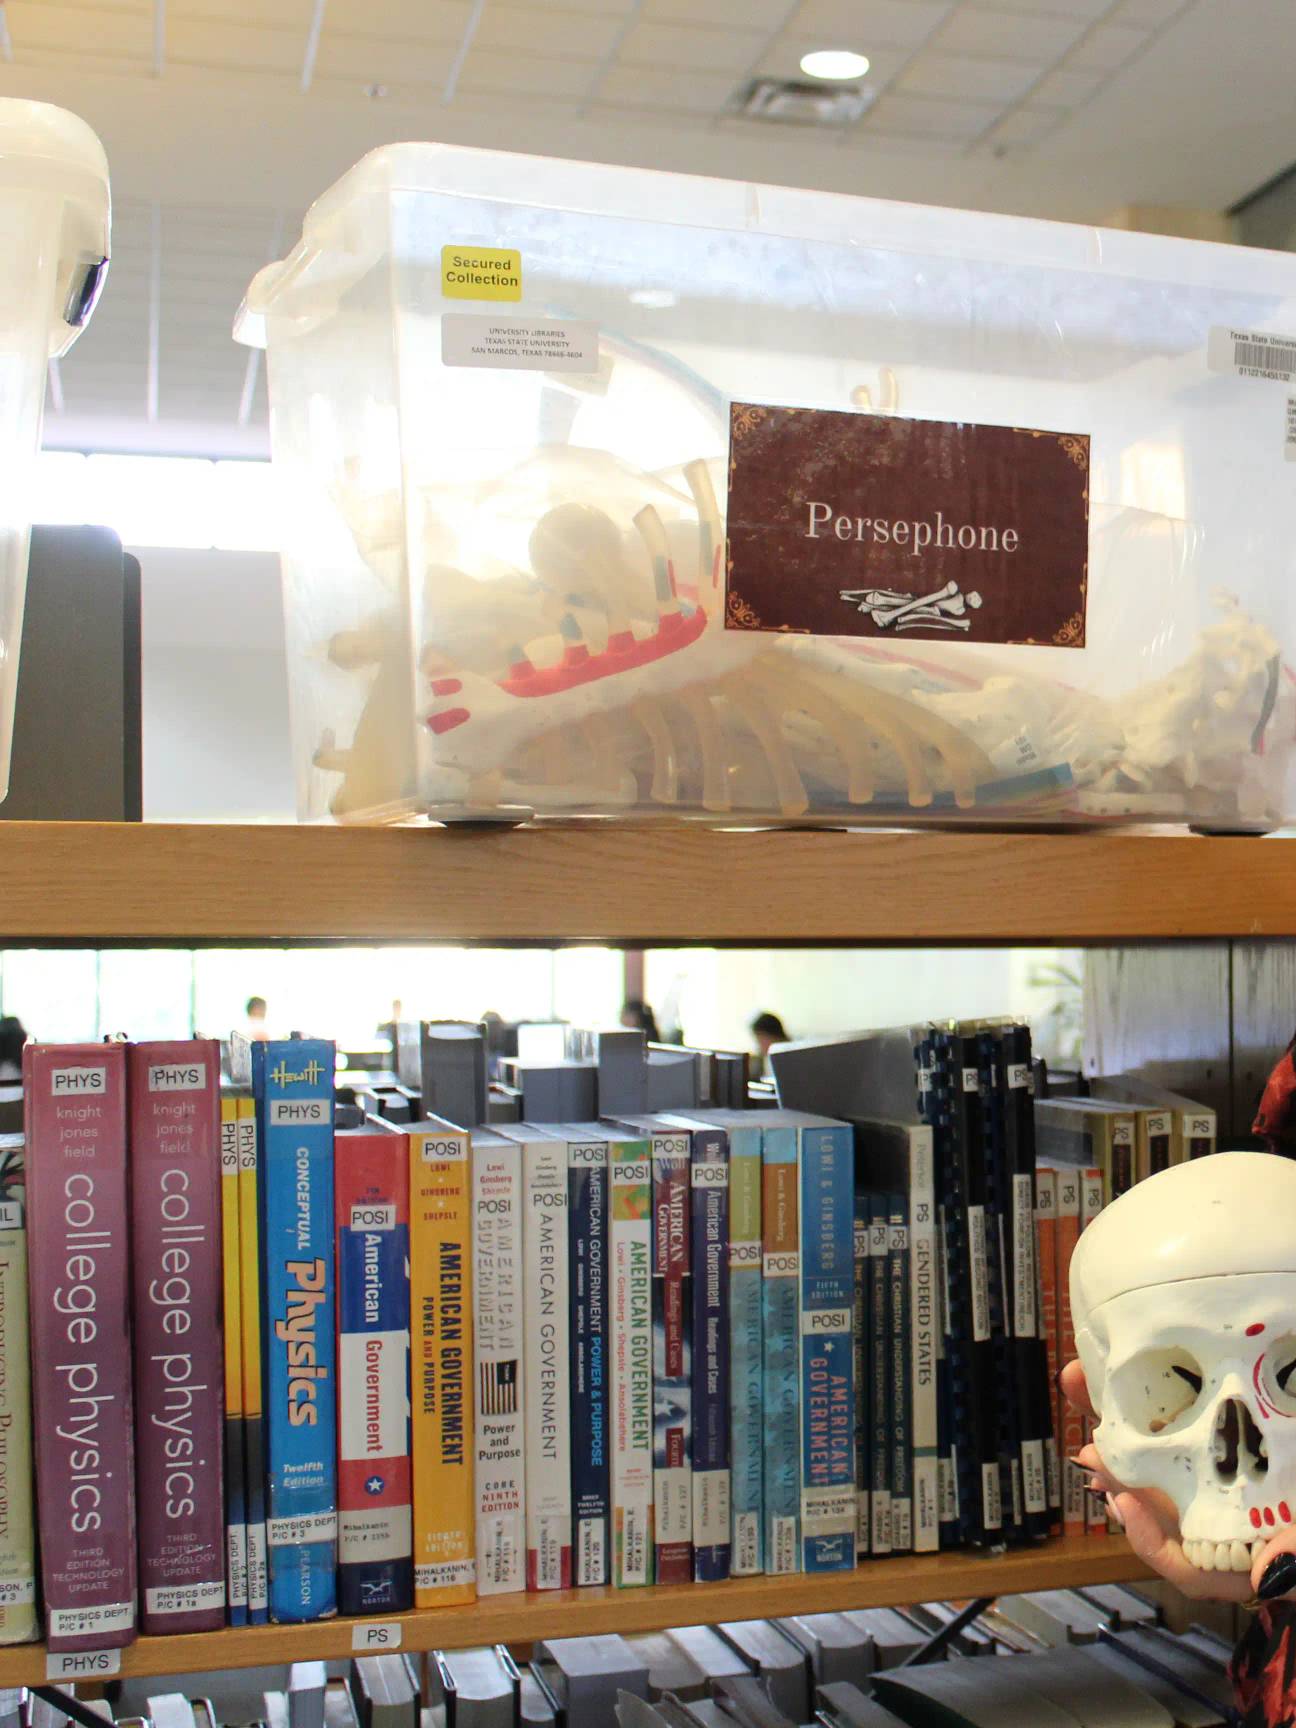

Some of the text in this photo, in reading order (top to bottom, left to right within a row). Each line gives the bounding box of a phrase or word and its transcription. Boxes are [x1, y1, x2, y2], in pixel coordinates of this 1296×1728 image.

[453, 256, 511, 270] Secured
[446, 271, 518, 286] Collection
[490, 328, 566, 338] UNIVERSITY LIBRARIES
[1230, 331, 1249, 341] Texas
[1251, 334, 1268, 344] State
[485, 337, 570, 348] TEXAS STATE UNIVERSITY
[487, 348, 520, 356] MARCOS,
[804, 502, 1019, 556] Persephone
[56, 1073, 102, 1088] PHYS
[154, 1069, 200, 1086] PHYS
[270, 1060, 325, 1088] Hewitt
[56, 1105, 102, 1122] knight
[153, 1102, 196, 1118] knight
[278, 1104, 321, 1118] PHYS
[156, 1121, 193, 1138] jones
[1150, 1118, 1164, 1130] PS
[1193, 1120, 1209, 1132] PS
[60, 1126, 98, 1142] jones
[1114, 1128, 1129, 1140] PS
[64, 1146, 96, 1158] field
[160, 1142, 190, 1154] field
[222, 1123, 236, 1166] PHYS
[242, 1124, 256, 1167] PHYS
[425, 1142, 460, 1156] POSI
[654, 1140, 688, 1152] POSI
[574, 1148, 608, 1162] POSI
[820, 1136, 833, 1172] LOWI
[486, 1164, 504, 1172] Lowi
[614, 1166, 649, 1180] POSI
[695, 1168, 728, 1181] POSI
[480, 1176, 512, 1186] Ginsberg
[297, 1147, 310, 1250] CONCEPTUAL
[420, 1188, 460, 1197] GINSBERG
[1040, 1190, 1051, 1208] PS
[1064, 1186, 1075, 1204] PS
[1089, 1188, 1100, 1207] PS
[478, 1200, 511, 1214] POSI
[534, 1194, 568, 1207] POSI
[352, 1210, 389, 1224] POSI
[423, 1212, 458, 1221] SHEPSLE
[706, 1190, 722, 1240] American
[916, 1203, 929, 1222] PS
[670, 1182, 687, 1262] AMERICAN
[658, 1204, 670, 1272] GOVERNMENT
[821, 1196, 834, 1270] GINSBERG
[873, 1227, 886, 1246] PS
[892, 1229, 905, 1248] PS
[855, 1235, 865, 1254] PS
[730, 1246, 761, 1260] POSI
[707, 1244, 721, 1308] Government
[497, 1217, 514, 1351] AMERICAN
[816, 1281, 839, 1289] FIFTH
[811, 1290, 844, 1299] EDITION
[589, 1167, 602, 1466] AMERICAN GOVERNMENT POWER & PURPOSE
[916, 1239, 932, 1386] GENDERED STATES
[670, 1282, 681, 1368] Readings and Cases
[747, 1279, 760, 1375] AMERICAN
[812, 1314, 845, 1328] POSI
[275, 1256, 328, 1427] Physics
[540, 1213, 558, 1459] AMERICAN GOVERNMENT
[707, 1316, 719, 1352] Readings
[149, 1168, 207, 1519] college physics
[364, 1234, 383, 1452] American Government
[616, 1242, 626, 1452] Lowi Ginsberg Shepsle Ansolabehere
[630, 1241, 650, 1451] AMERICAN GOVERNMENT
[54, 1174, 115, 1533] college physics
[422, 1297, 436, 1415] POWER AND PURPOSE
[440, 1242, 463, 1466] AMERICAN GOVERNMENT
[708, 1354, 719, 1370] and
[708, 1371, 719, 1394] Cases
[810, 1358, 828, 1483] GOVERNMENT
[831, 1376, 848, 1474] AMERICAN
[484, 1424, 516, 1436] Power
[490, 1436, 509, 1447] and
[747, 1382, 760, 1513] GOVERNMENT
[479, 1448, 520, 1461] Purpose
[283, 1461, 324, 1474] Twelfth
[283, 1475, 324, 1488] Edition
[485, 1480, 516, 1491] CORE
[482, 1491, 518, 1501] NINTH
[482, 1502, 520, 1513] EDITION
[272, 1516, 336, 1531] PHYSICS DEPT
[166, 1533, 198, 1543] THIRD
[272, 1530, 305, 1540] P/C # 3
[72, 1547, 104, 1556] THIRD
[161, 1544, 202, 1555] EDITION
[66, 1558, 110, 1570] EDITION
[148, 1552, 216, 1567] TECHNOLOGY
[52, 1568, 125, 1582] TECHNOLOGY
[162, 1566, 202, 1578] UPDATE
[231, 1557, 240, 1600] PHYSICS
[250, 1559, 258, 1600] PHYSICS
[301, 1550, 311, 1606] PEARSON
[68, 1582, 110, 1593] UPDATE
[415, 1576, 429, 1585] P/C
[157, 1586, 224, 1600] PHYSICS DEPT
[157, 1599, 196, 1609] P/C # 1a
[58, 1609, 102, 1622] PHYSICS
[58, 1621, 94, 1631] P/C # 1
[367, 1629, 388, 1642] PS
[62, 1654, 110, 1672] PHYS
